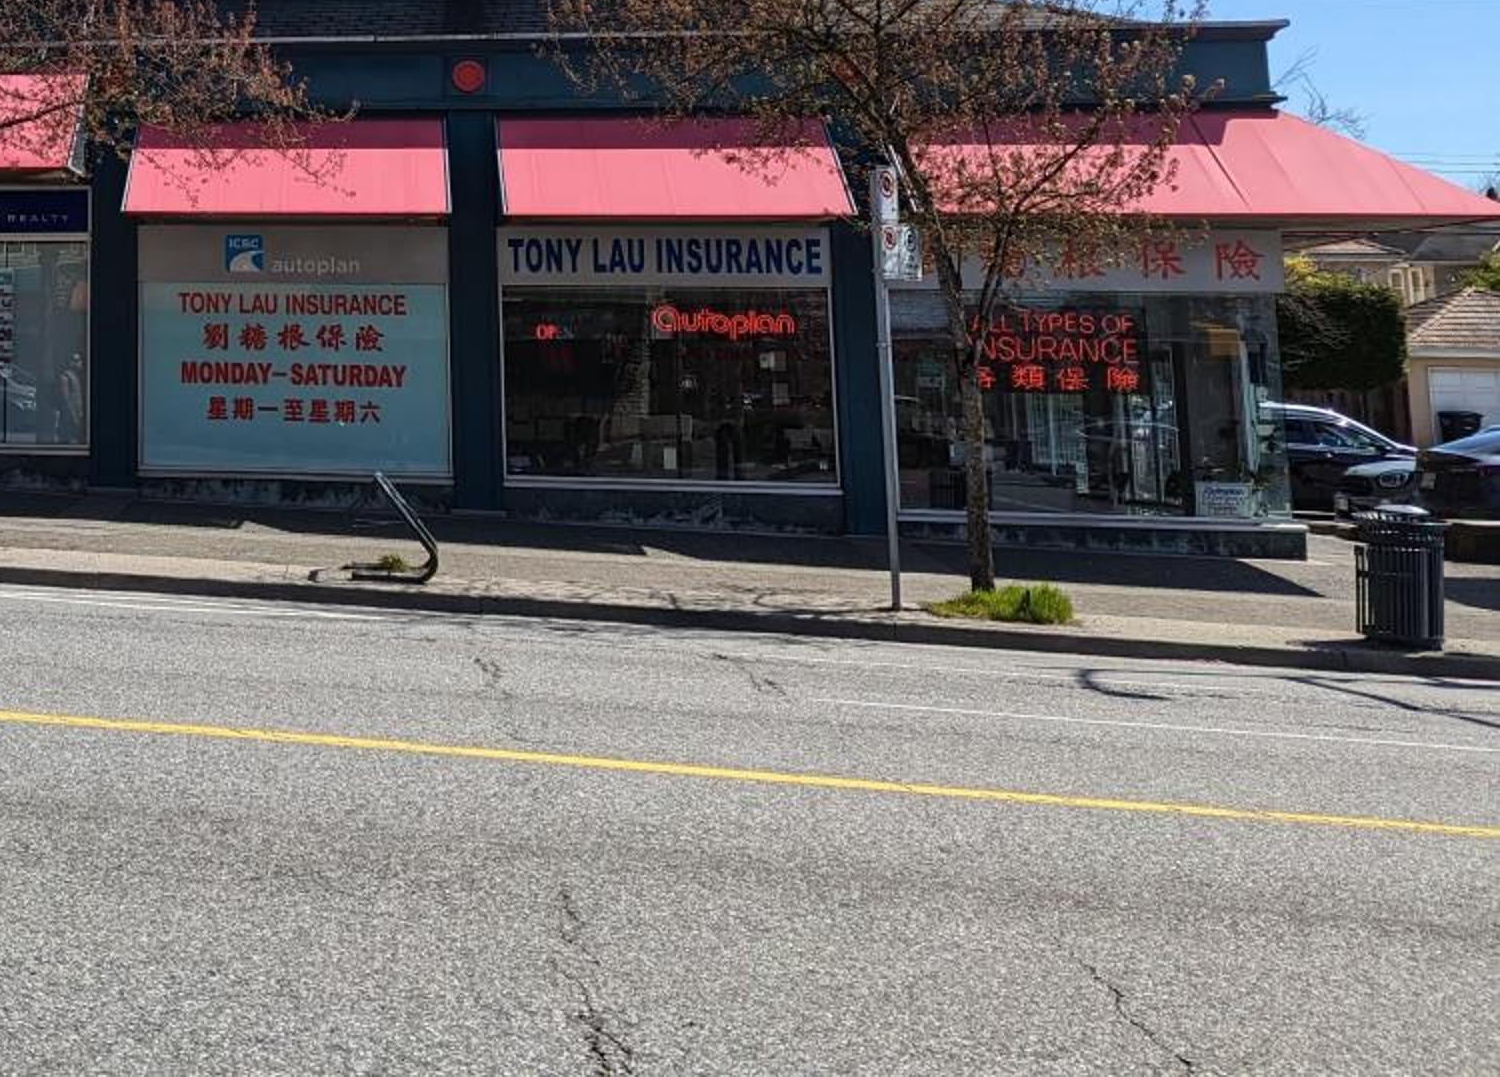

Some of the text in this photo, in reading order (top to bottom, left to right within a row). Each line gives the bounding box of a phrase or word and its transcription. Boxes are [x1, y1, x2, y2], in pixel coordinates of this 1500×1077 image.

[7, 214, 69, 223] REALTY
[272, 256, 361, 275] autoplan
[507, 238, 823, 275] TONY LAU INSURANCE
[178, 292, 407, 316] TONY LAU INSURANCE
[1018, 312, 1095, 334] TYPES
[1101, 314, 1135, 334] OF
[976, 335, 1139, 365] NSURANCE
[206, 396, 382, 423] 星期一至星期六
